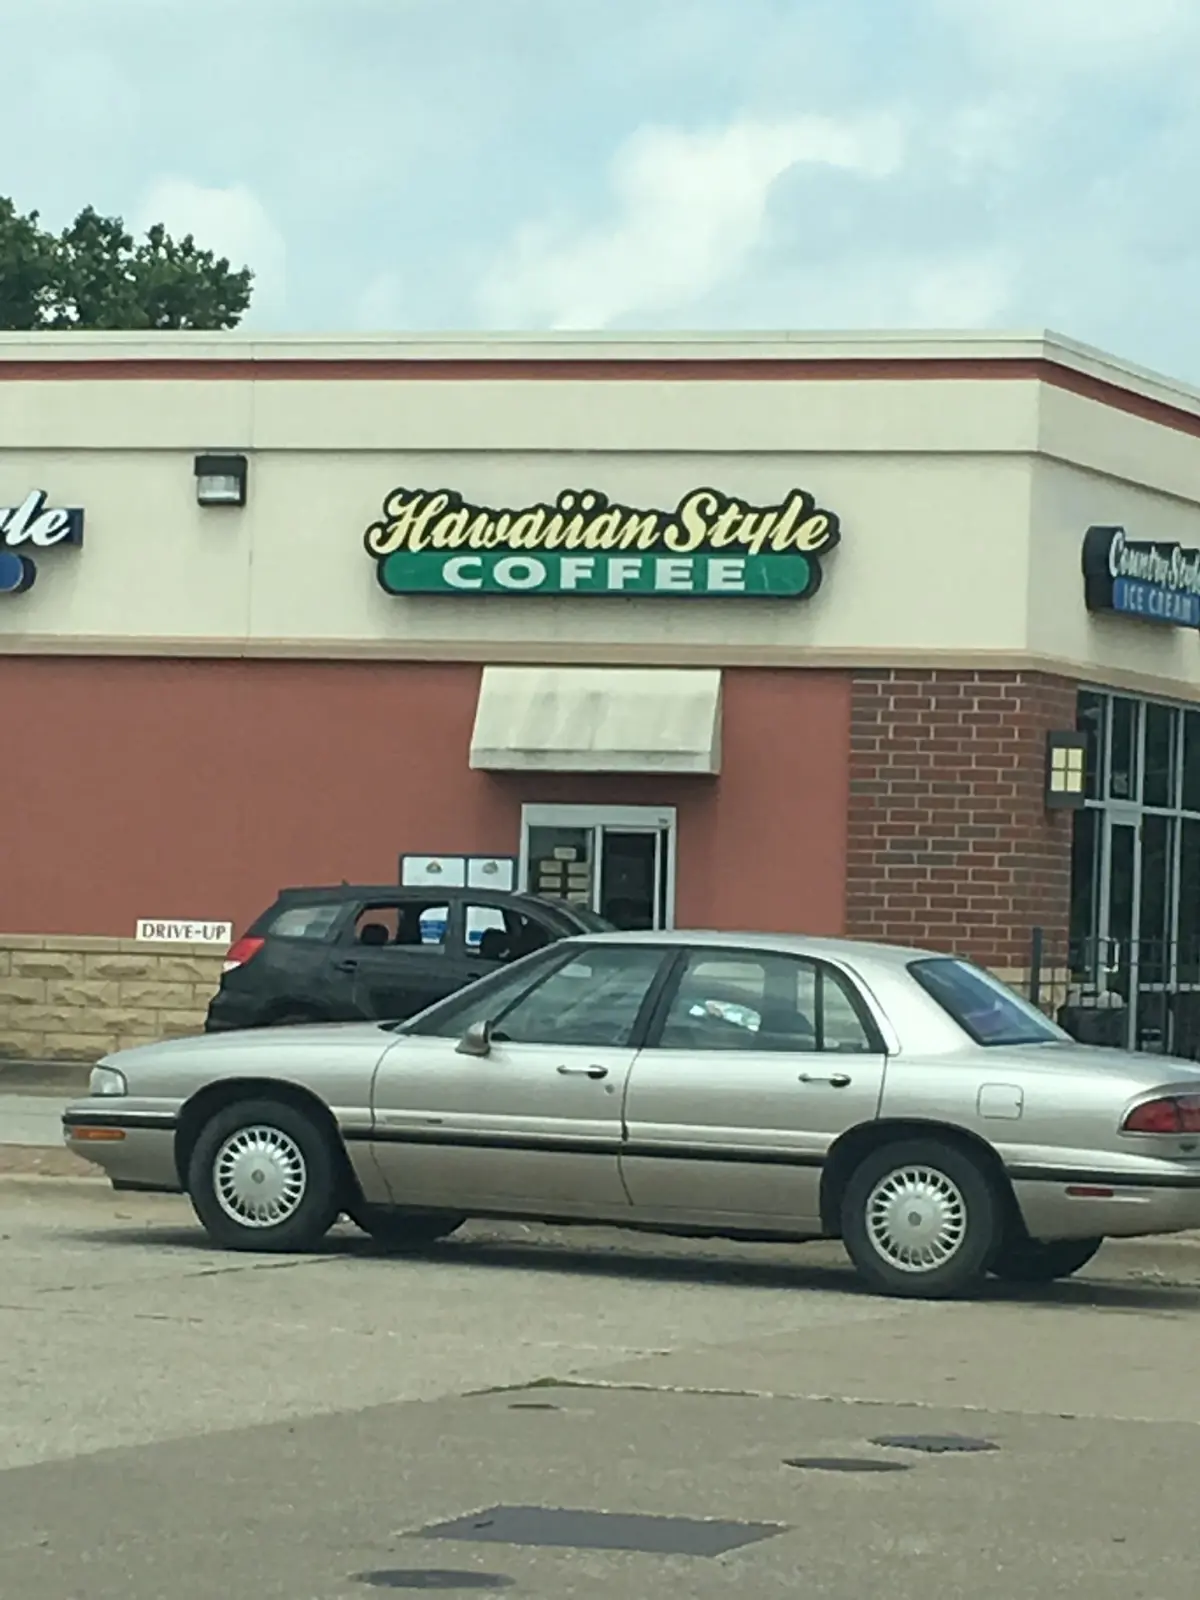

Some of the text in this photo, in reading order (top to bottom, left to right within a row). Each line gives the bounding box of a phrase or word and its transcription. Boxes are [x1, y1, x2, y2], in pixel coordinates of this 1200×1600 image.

[368, 492, 830, 554] Hawaiian Style
[441, 556, 746, 591] COFFEE
[1124, 582, 1192, 622] ICE CREAM
[141, 922, 226, 940] DRIVE-UP
